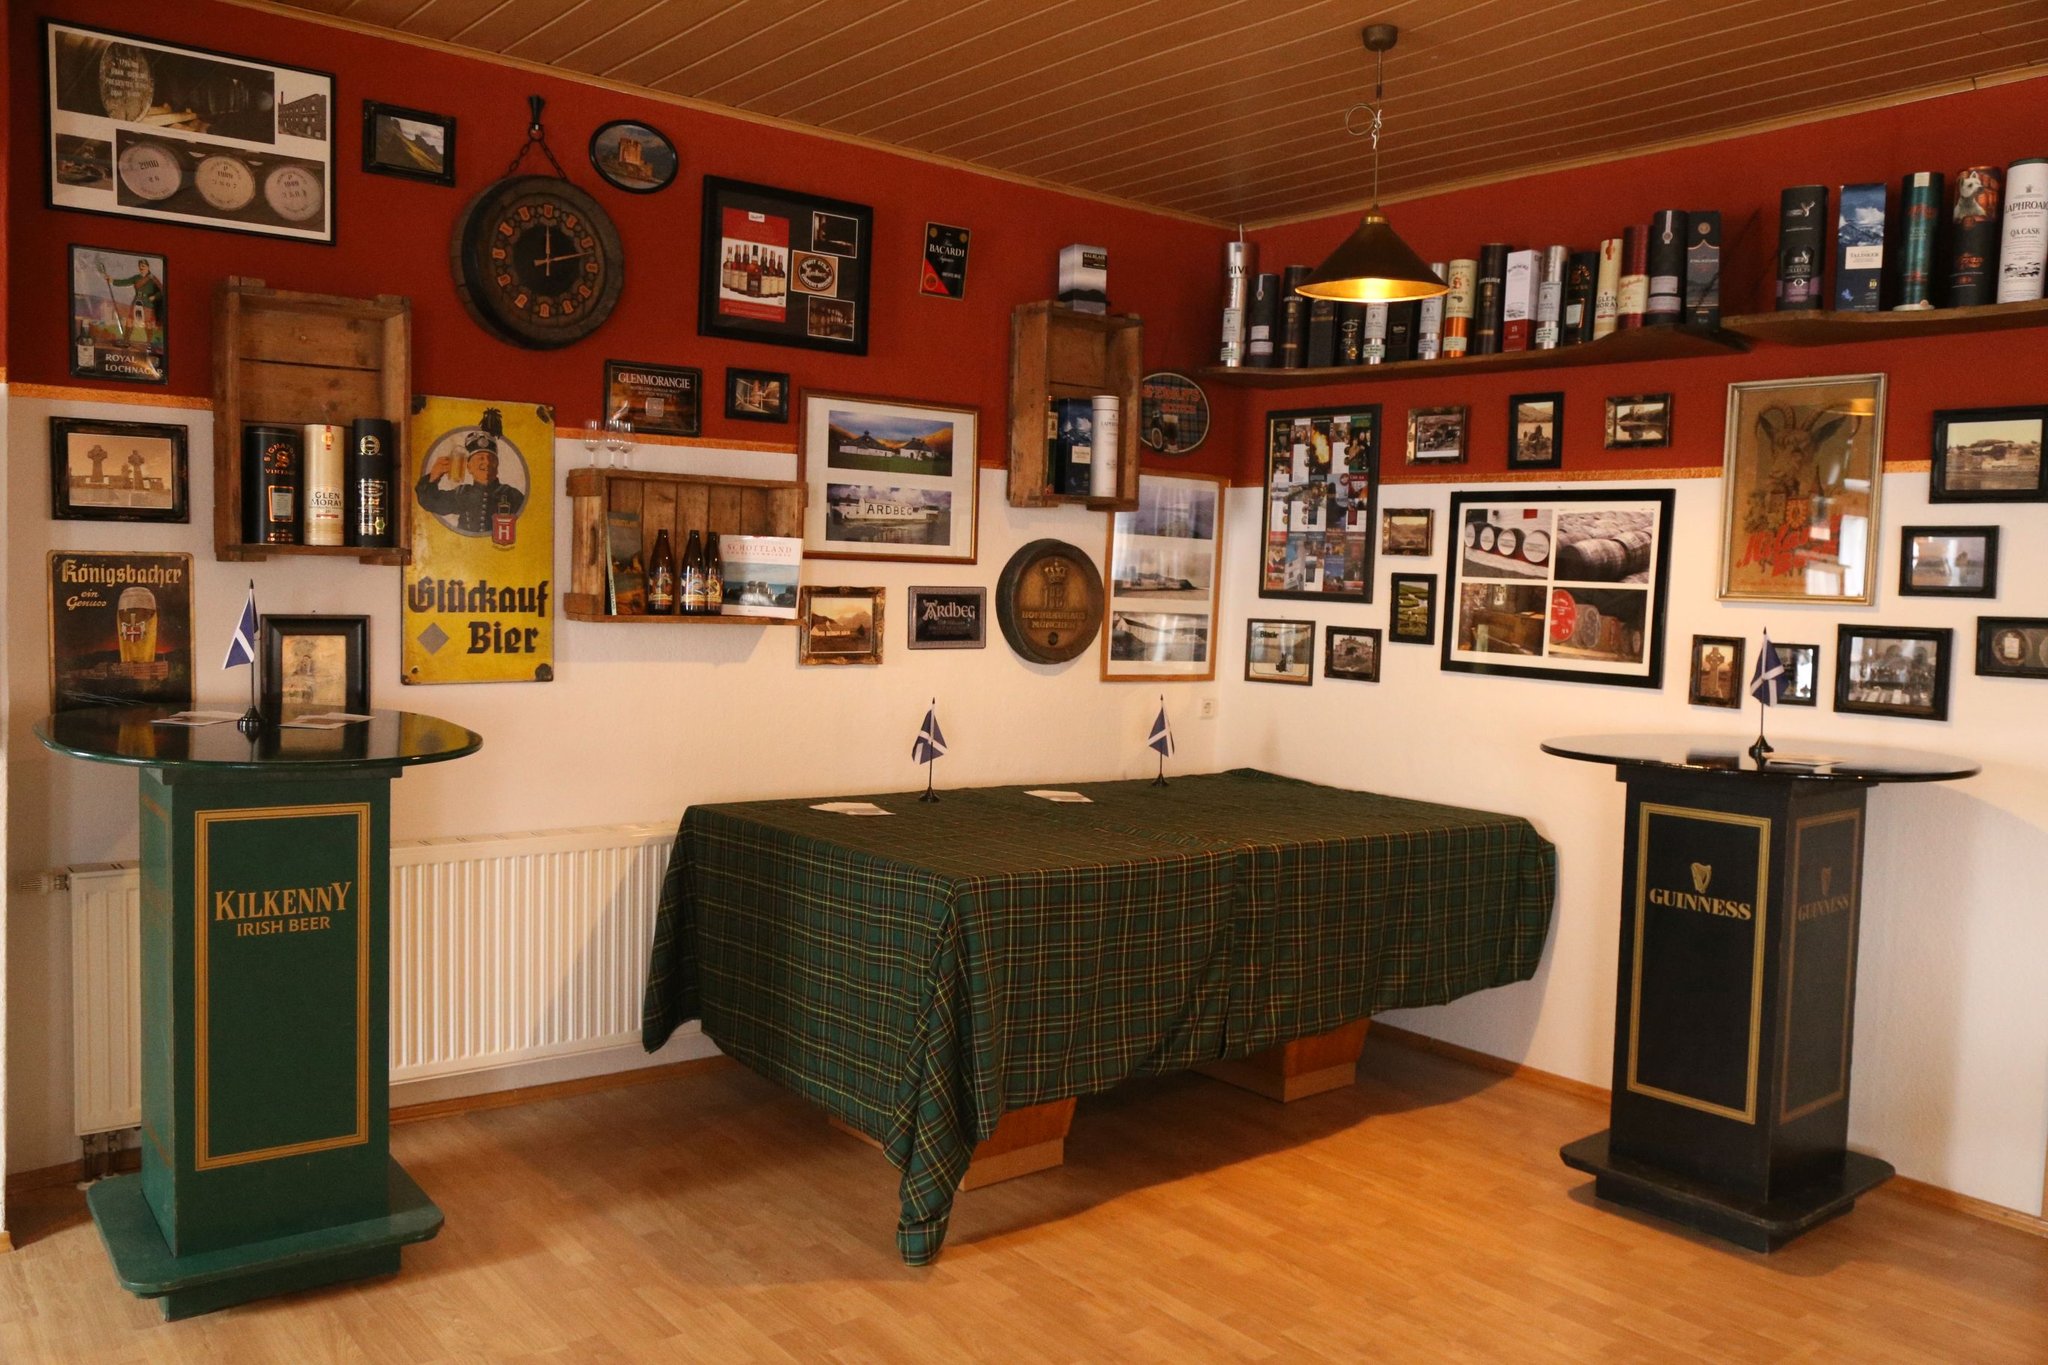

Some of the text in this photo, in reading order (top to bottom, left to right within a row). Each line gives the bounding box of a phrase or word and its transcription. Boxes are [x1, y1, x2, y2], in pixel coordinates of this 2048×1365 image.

[929, 244, 965, 257] BACARDI
[105, 353, 137, 363] ROYAL
[618, 372, 691, 389] GLENMORANGIE
[312, 499, 342, 507] MORAY
[315, 491, 340, 499] GLEN
[498, 525, 510, 540] H
[61, 559, 182, 587] Königsbacher
[408, 576, 549, 618] Glückauf
[466, 611, 539, 654] Bier
[215, 881, 352, 921] KILKENNY
[1650, 887, 1751, 921] GUINNESS
[1799, 895, 1850, 921] GUINNESS
[236, 916, 331, 937] IRISH BEER
